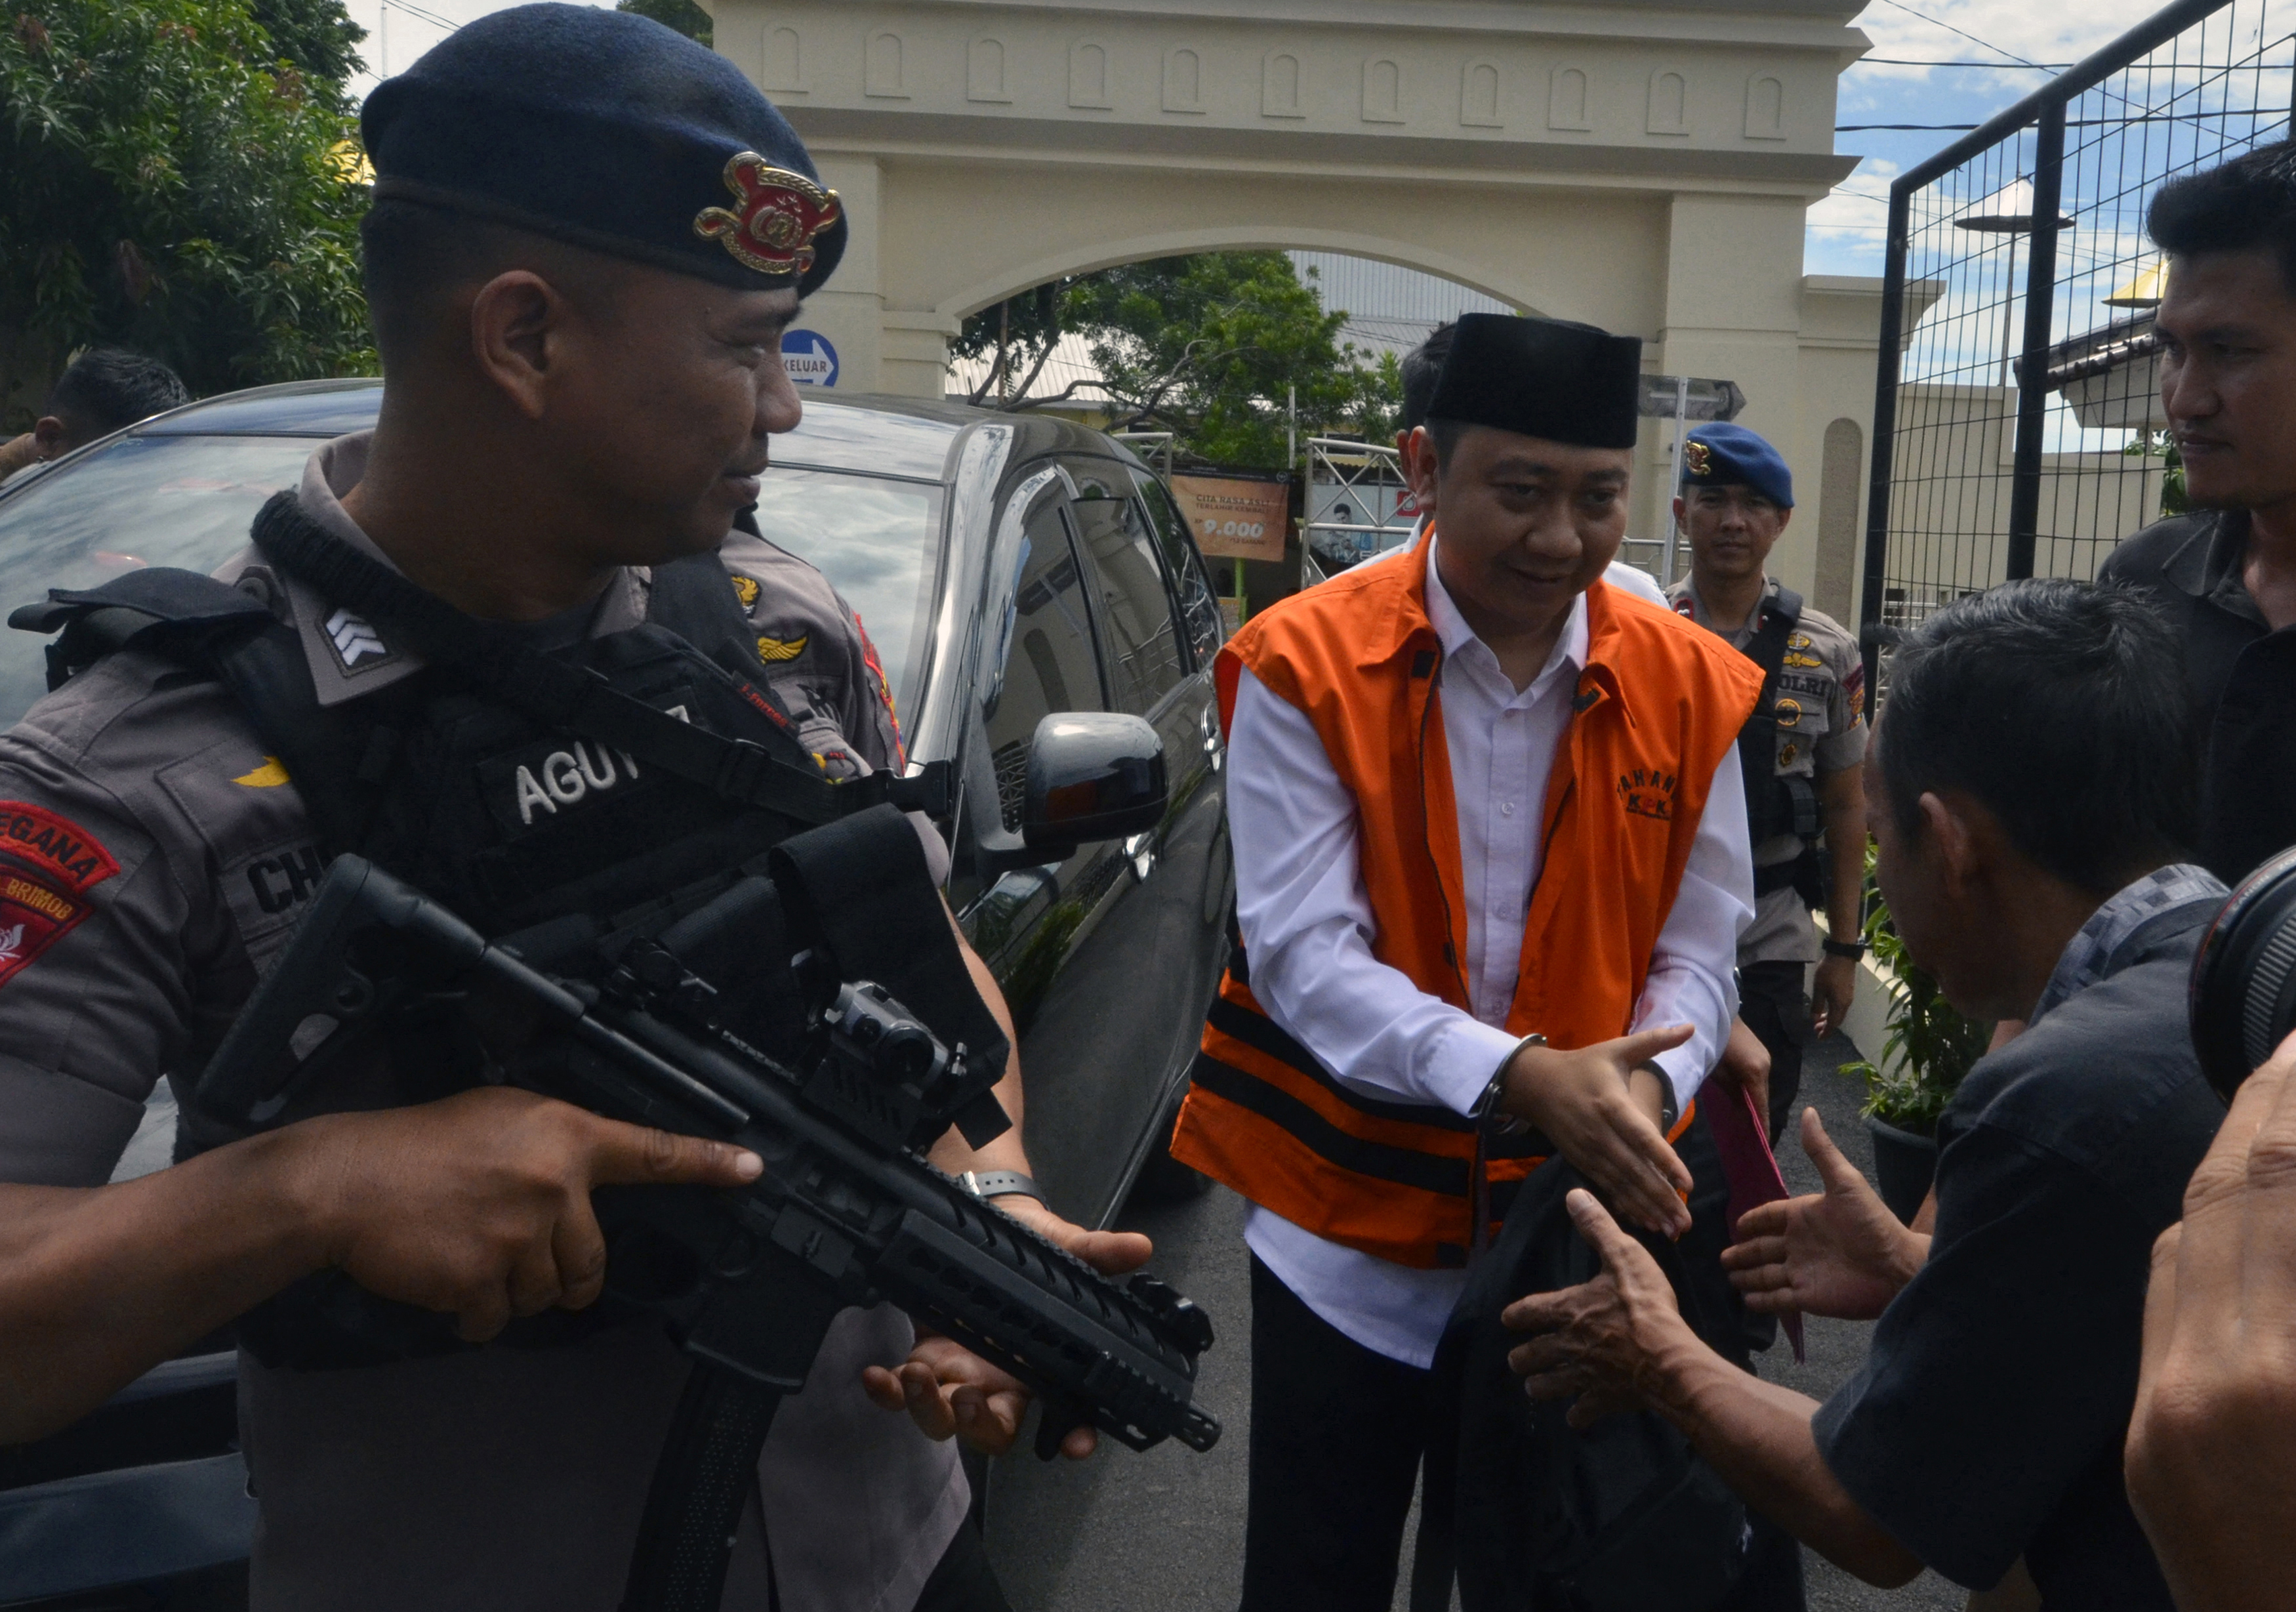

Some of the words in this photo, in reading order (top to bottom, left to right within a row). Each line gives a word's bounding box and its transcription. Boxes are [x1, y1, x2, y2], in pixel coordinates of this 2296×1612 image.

[1197, 494, 1217, 503] CITA
[1204, 518, 1265, 538] 9.000
[1778, 673, 1826, 696] OLRI
[6, 878, 73, 920] BRIMOB
